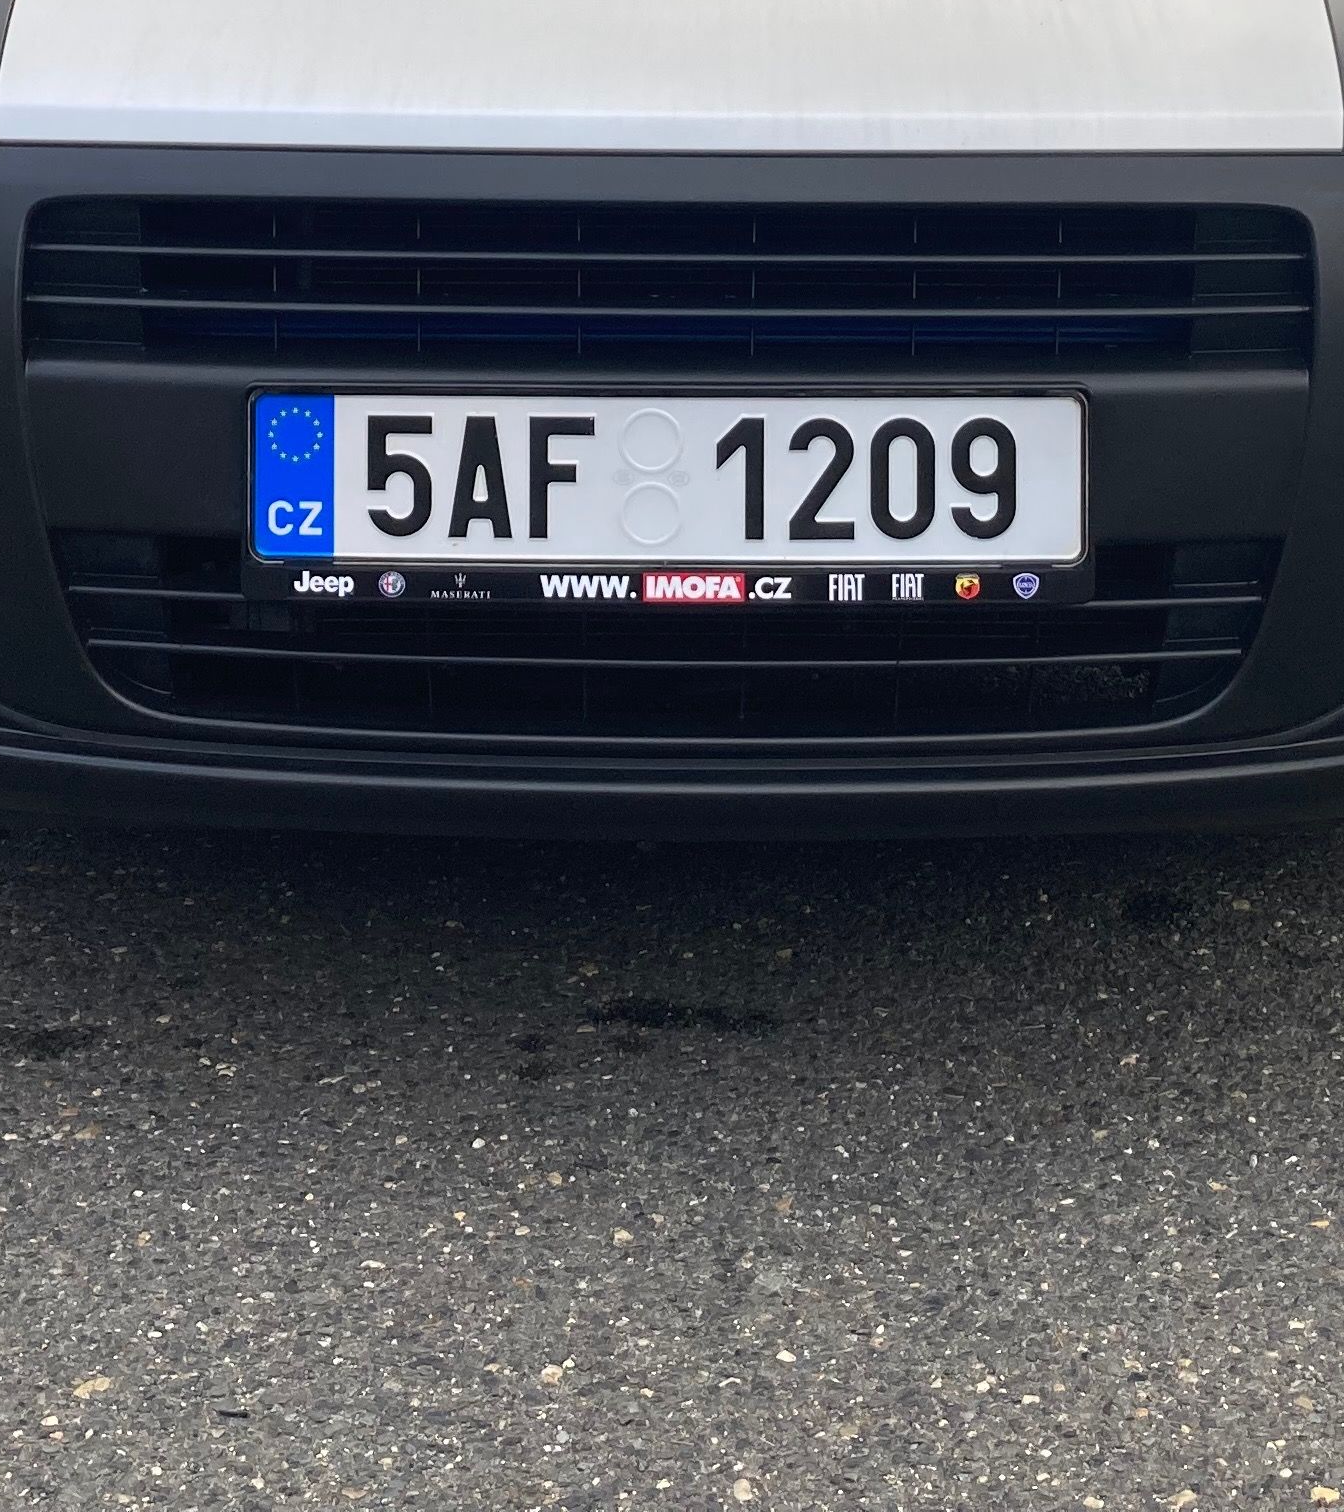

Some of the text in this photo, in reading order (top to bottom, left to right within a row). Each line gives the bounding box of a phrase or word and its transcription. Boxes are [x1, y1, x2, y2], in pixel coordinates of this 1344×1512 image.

[366, 414, 1017, 540] 5AF 1209
[267, 499, 323, 536] CZ
[293, 571, 355, 597] Jeep
[429, 590, 491, 600] MASERATI
[828, 573, 866, 601] FIAT
[891, 573, 925, 598] FIAT
